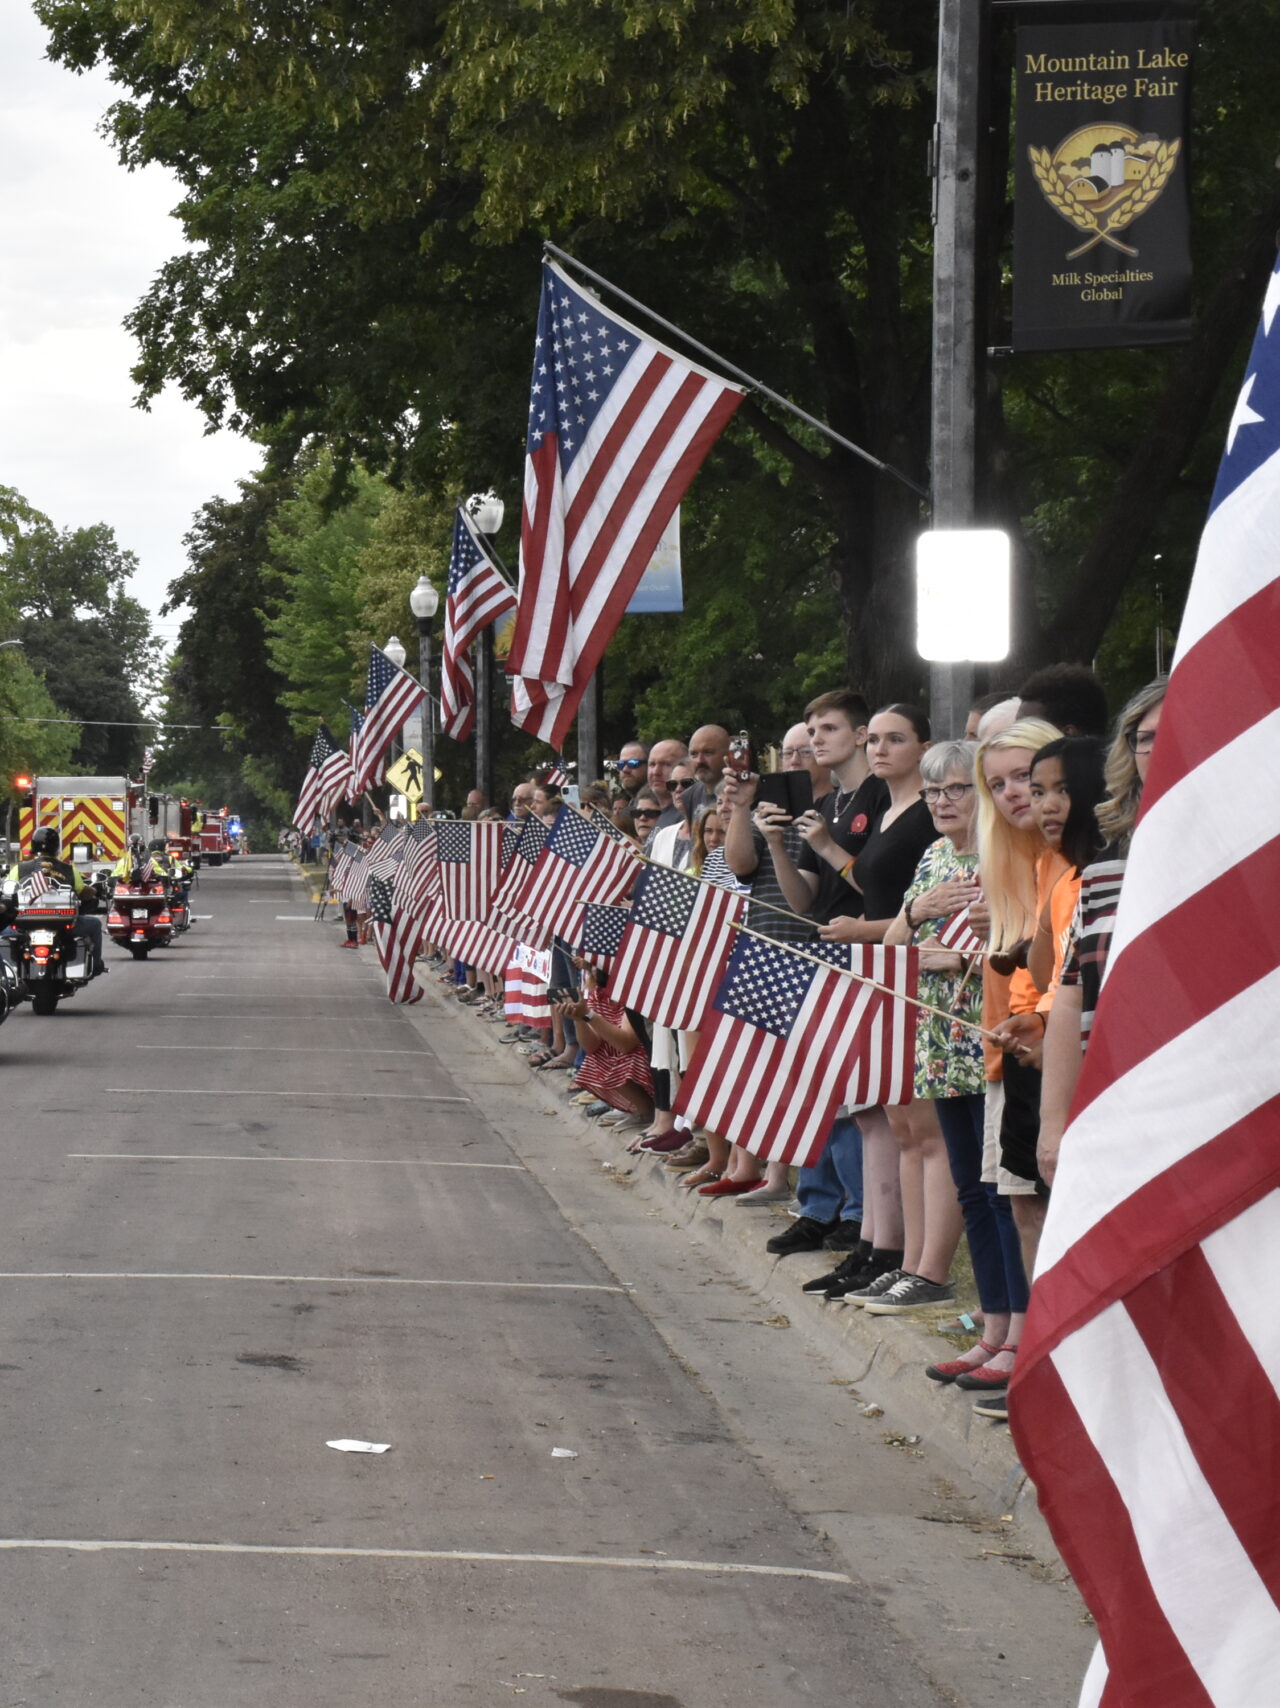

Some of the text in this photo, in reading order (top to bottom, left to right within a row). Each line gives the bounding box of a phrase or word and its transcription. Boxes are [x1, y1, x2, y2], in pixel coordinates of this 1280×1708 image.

[1024, 47, 1189, 74] Mountain Lake
[1035, 77, 1179, 104] Heritage Fair
[1051, 270, 1154, 286] Milk Specialties
[1080, 287, 1123, 302] Global
